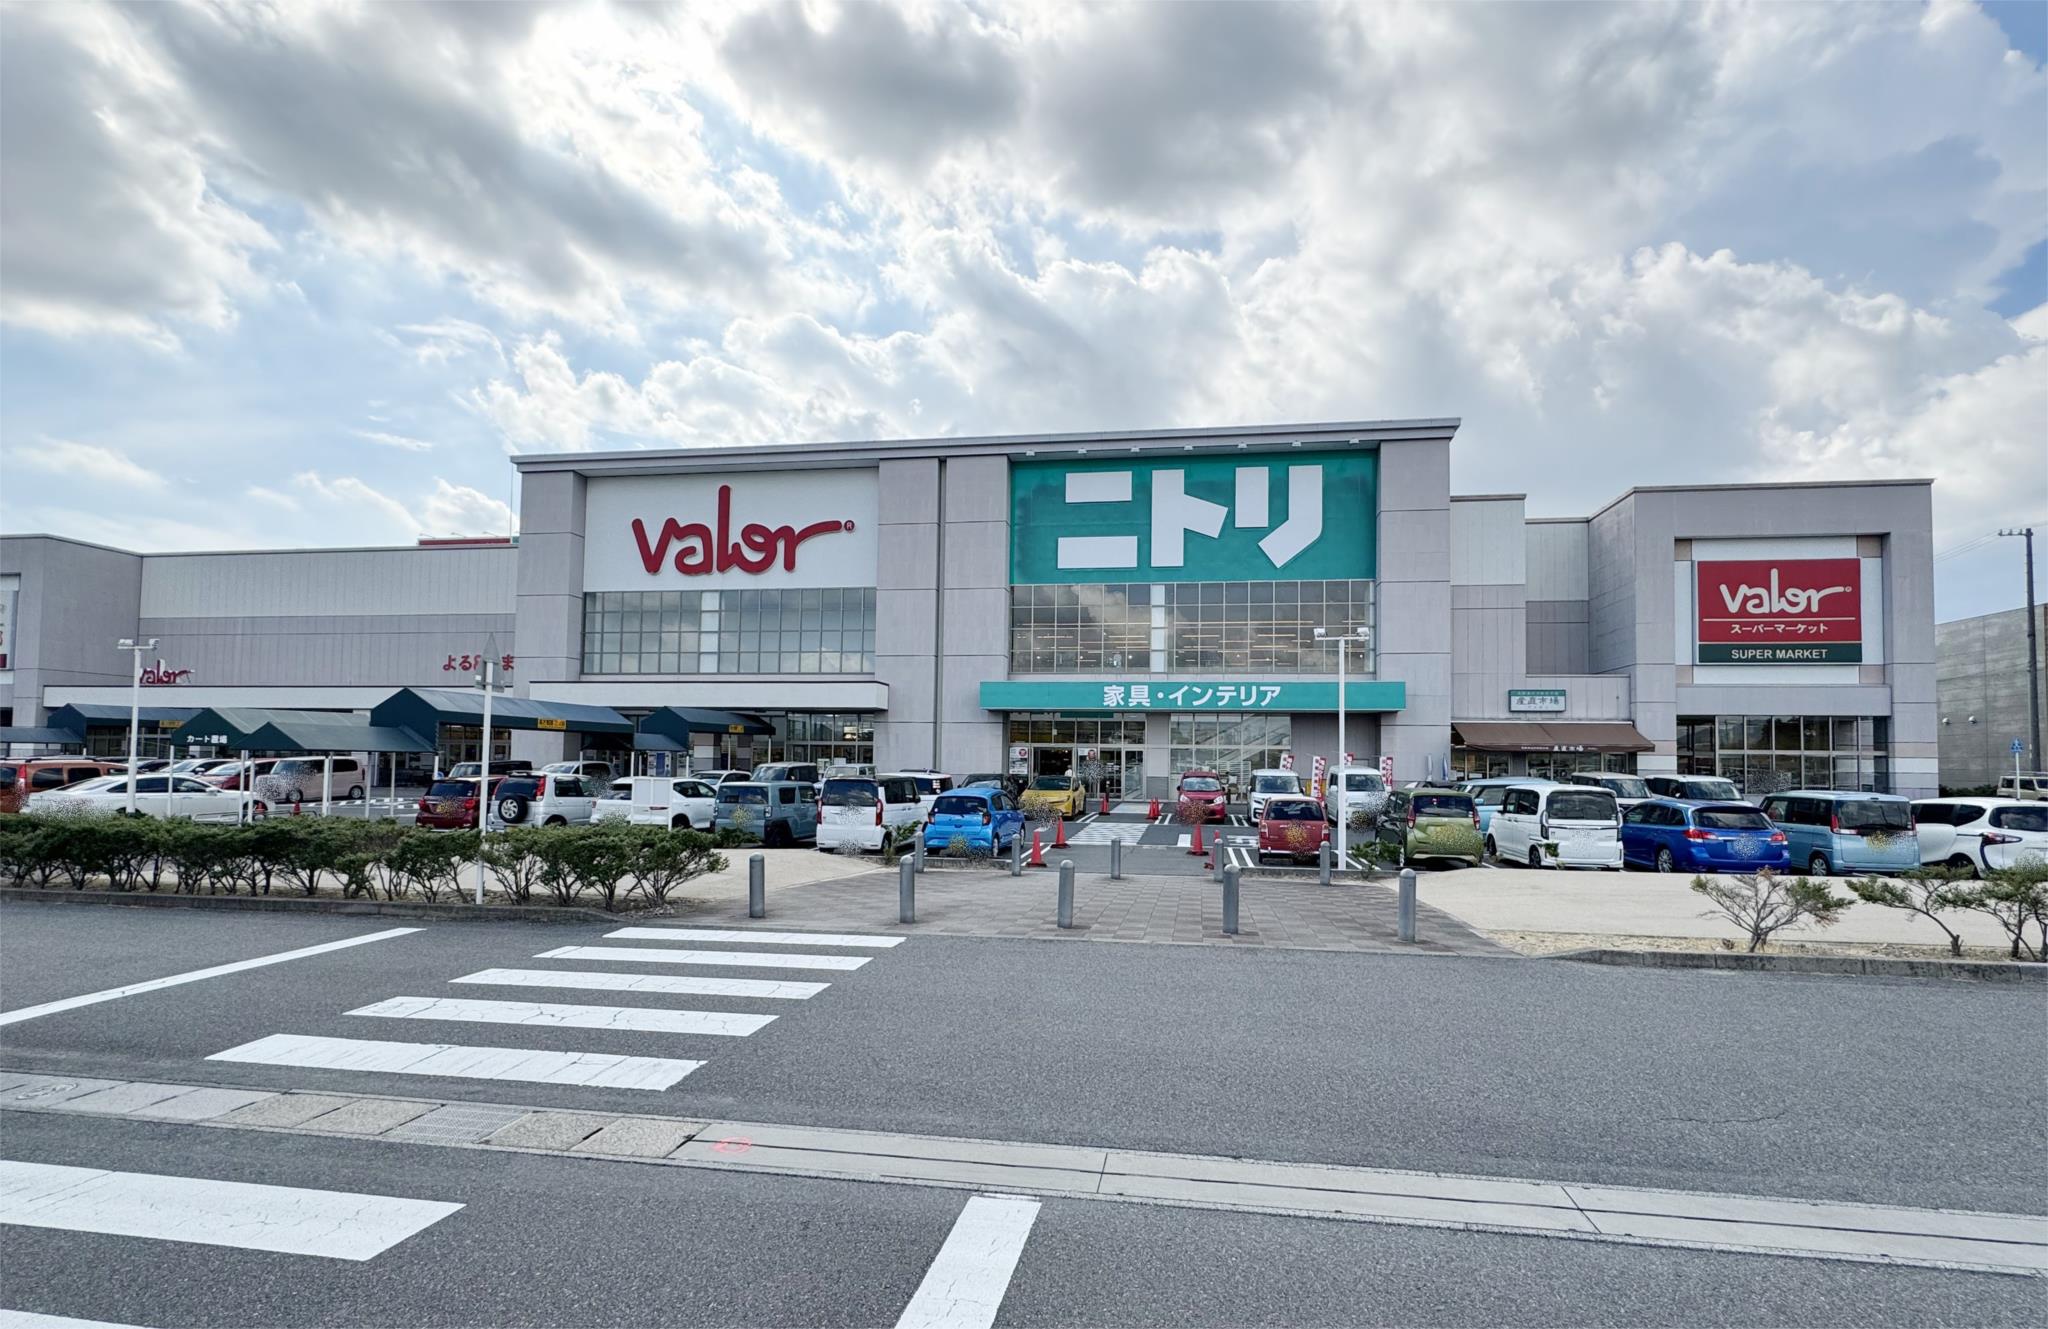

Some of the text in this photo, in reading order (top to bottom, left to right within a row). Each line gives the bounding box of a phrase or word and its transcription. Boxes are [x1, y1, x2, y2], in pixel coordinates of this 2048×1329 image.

[1056, 464, 1324, 570] ニトリ
[1730, 623, 1828, 634] スーパーマーケット
[1731, 649, 1828, 659] SUPER MARKET
[1102, 685, 1281, 707] 家具・インテリア
